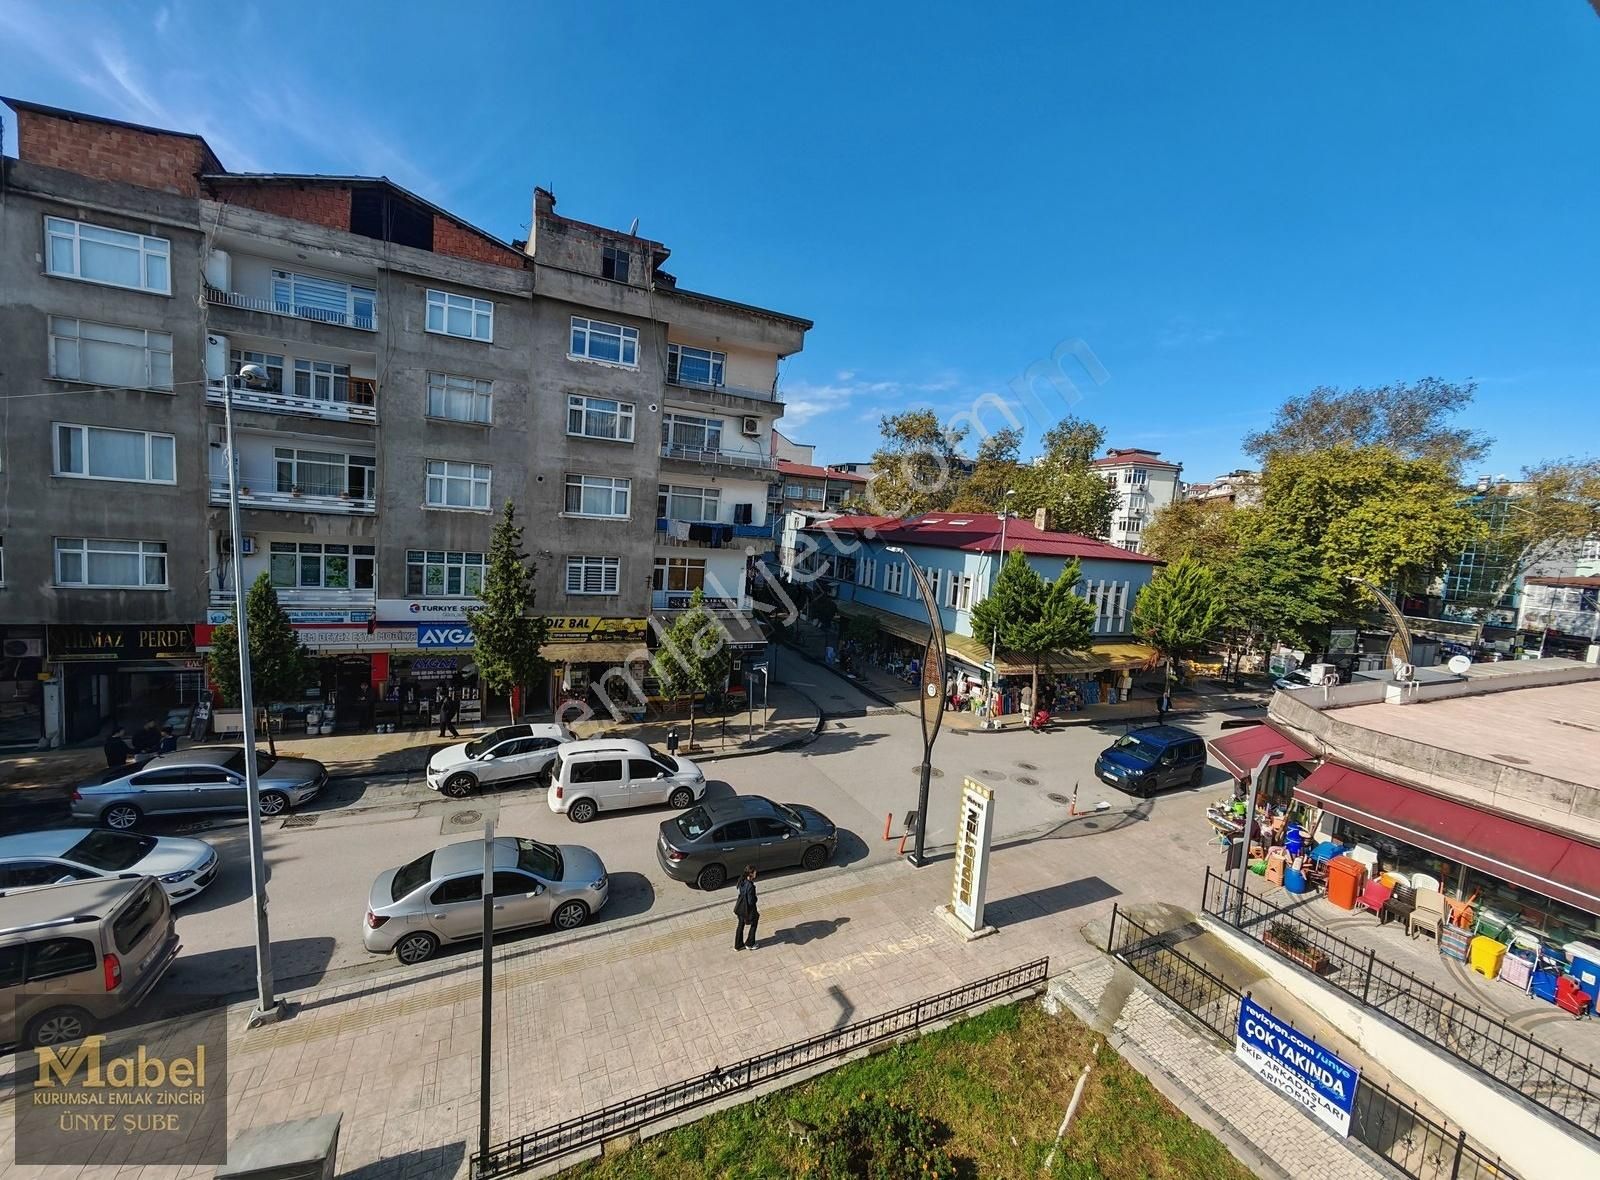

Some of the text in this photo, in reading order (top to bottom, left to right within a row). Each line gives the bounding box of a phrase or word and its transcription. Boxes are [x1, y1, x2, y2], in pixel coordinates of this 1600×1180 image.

[568, 618, 590, 628] BAL
[139, 630, 188, 648] PERDE
[420, 629, 477, 644] AYGA
[1246, 1005, 1315, 1056] revizyon.com
[1241, 1042, 1262, 1061] EKİP
[1245, 1019, 1274, 1050] ÇOK
[1277, 1042, 1344, 1097] YAKINDA
[1260, 1068, 1317, 1112] ARIYORUZ
